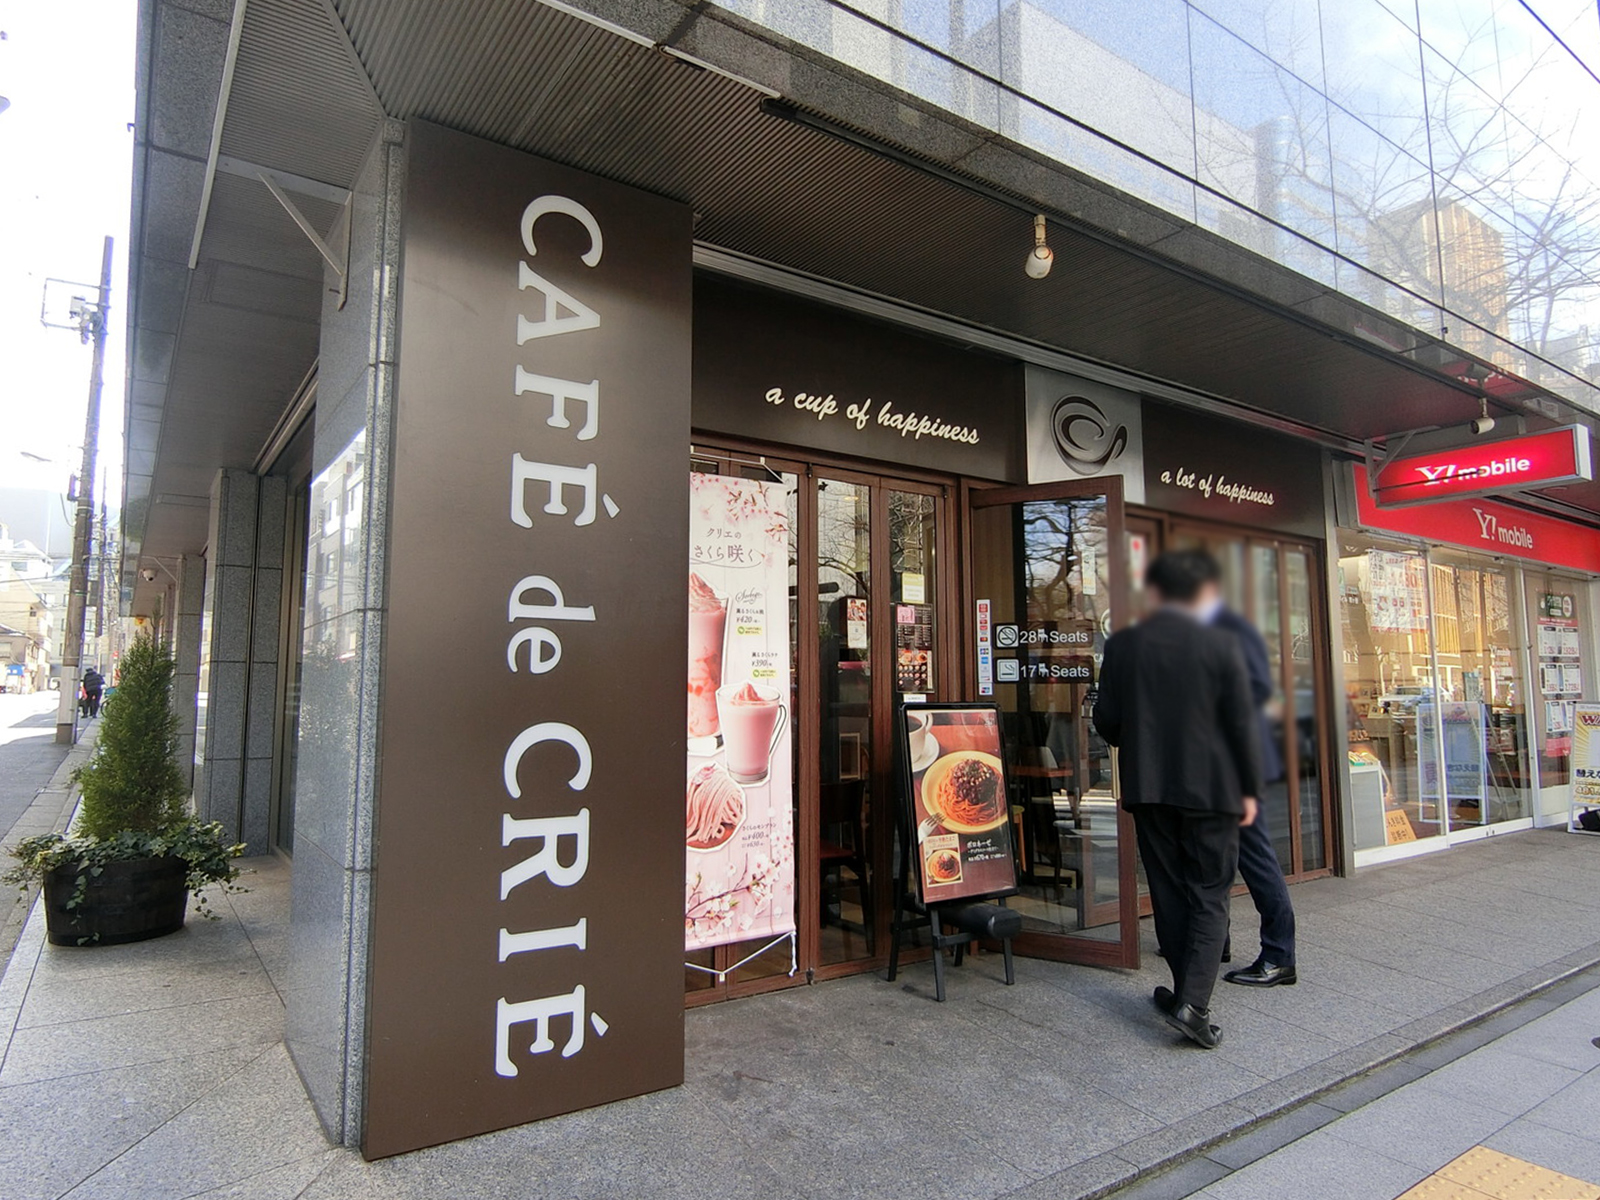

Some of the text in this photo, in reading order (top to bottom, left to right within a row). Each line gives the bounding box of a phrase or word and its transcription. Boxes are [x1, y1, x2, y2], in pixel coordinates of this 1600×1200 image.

[765, 387, 980, 445] a cup of happiness
[1160, 467, 1275, 505] a lot of happiness
[706, 527, 742, 540] クリエの
[694, 544, 754, 563] さくら咲く
[495, 195, 619, 1077] CAFÉ de CRIÉ
[1019, 630, 1088, 643] 28 Seats
[1020, 664, 1090, 678] 17 Seats
